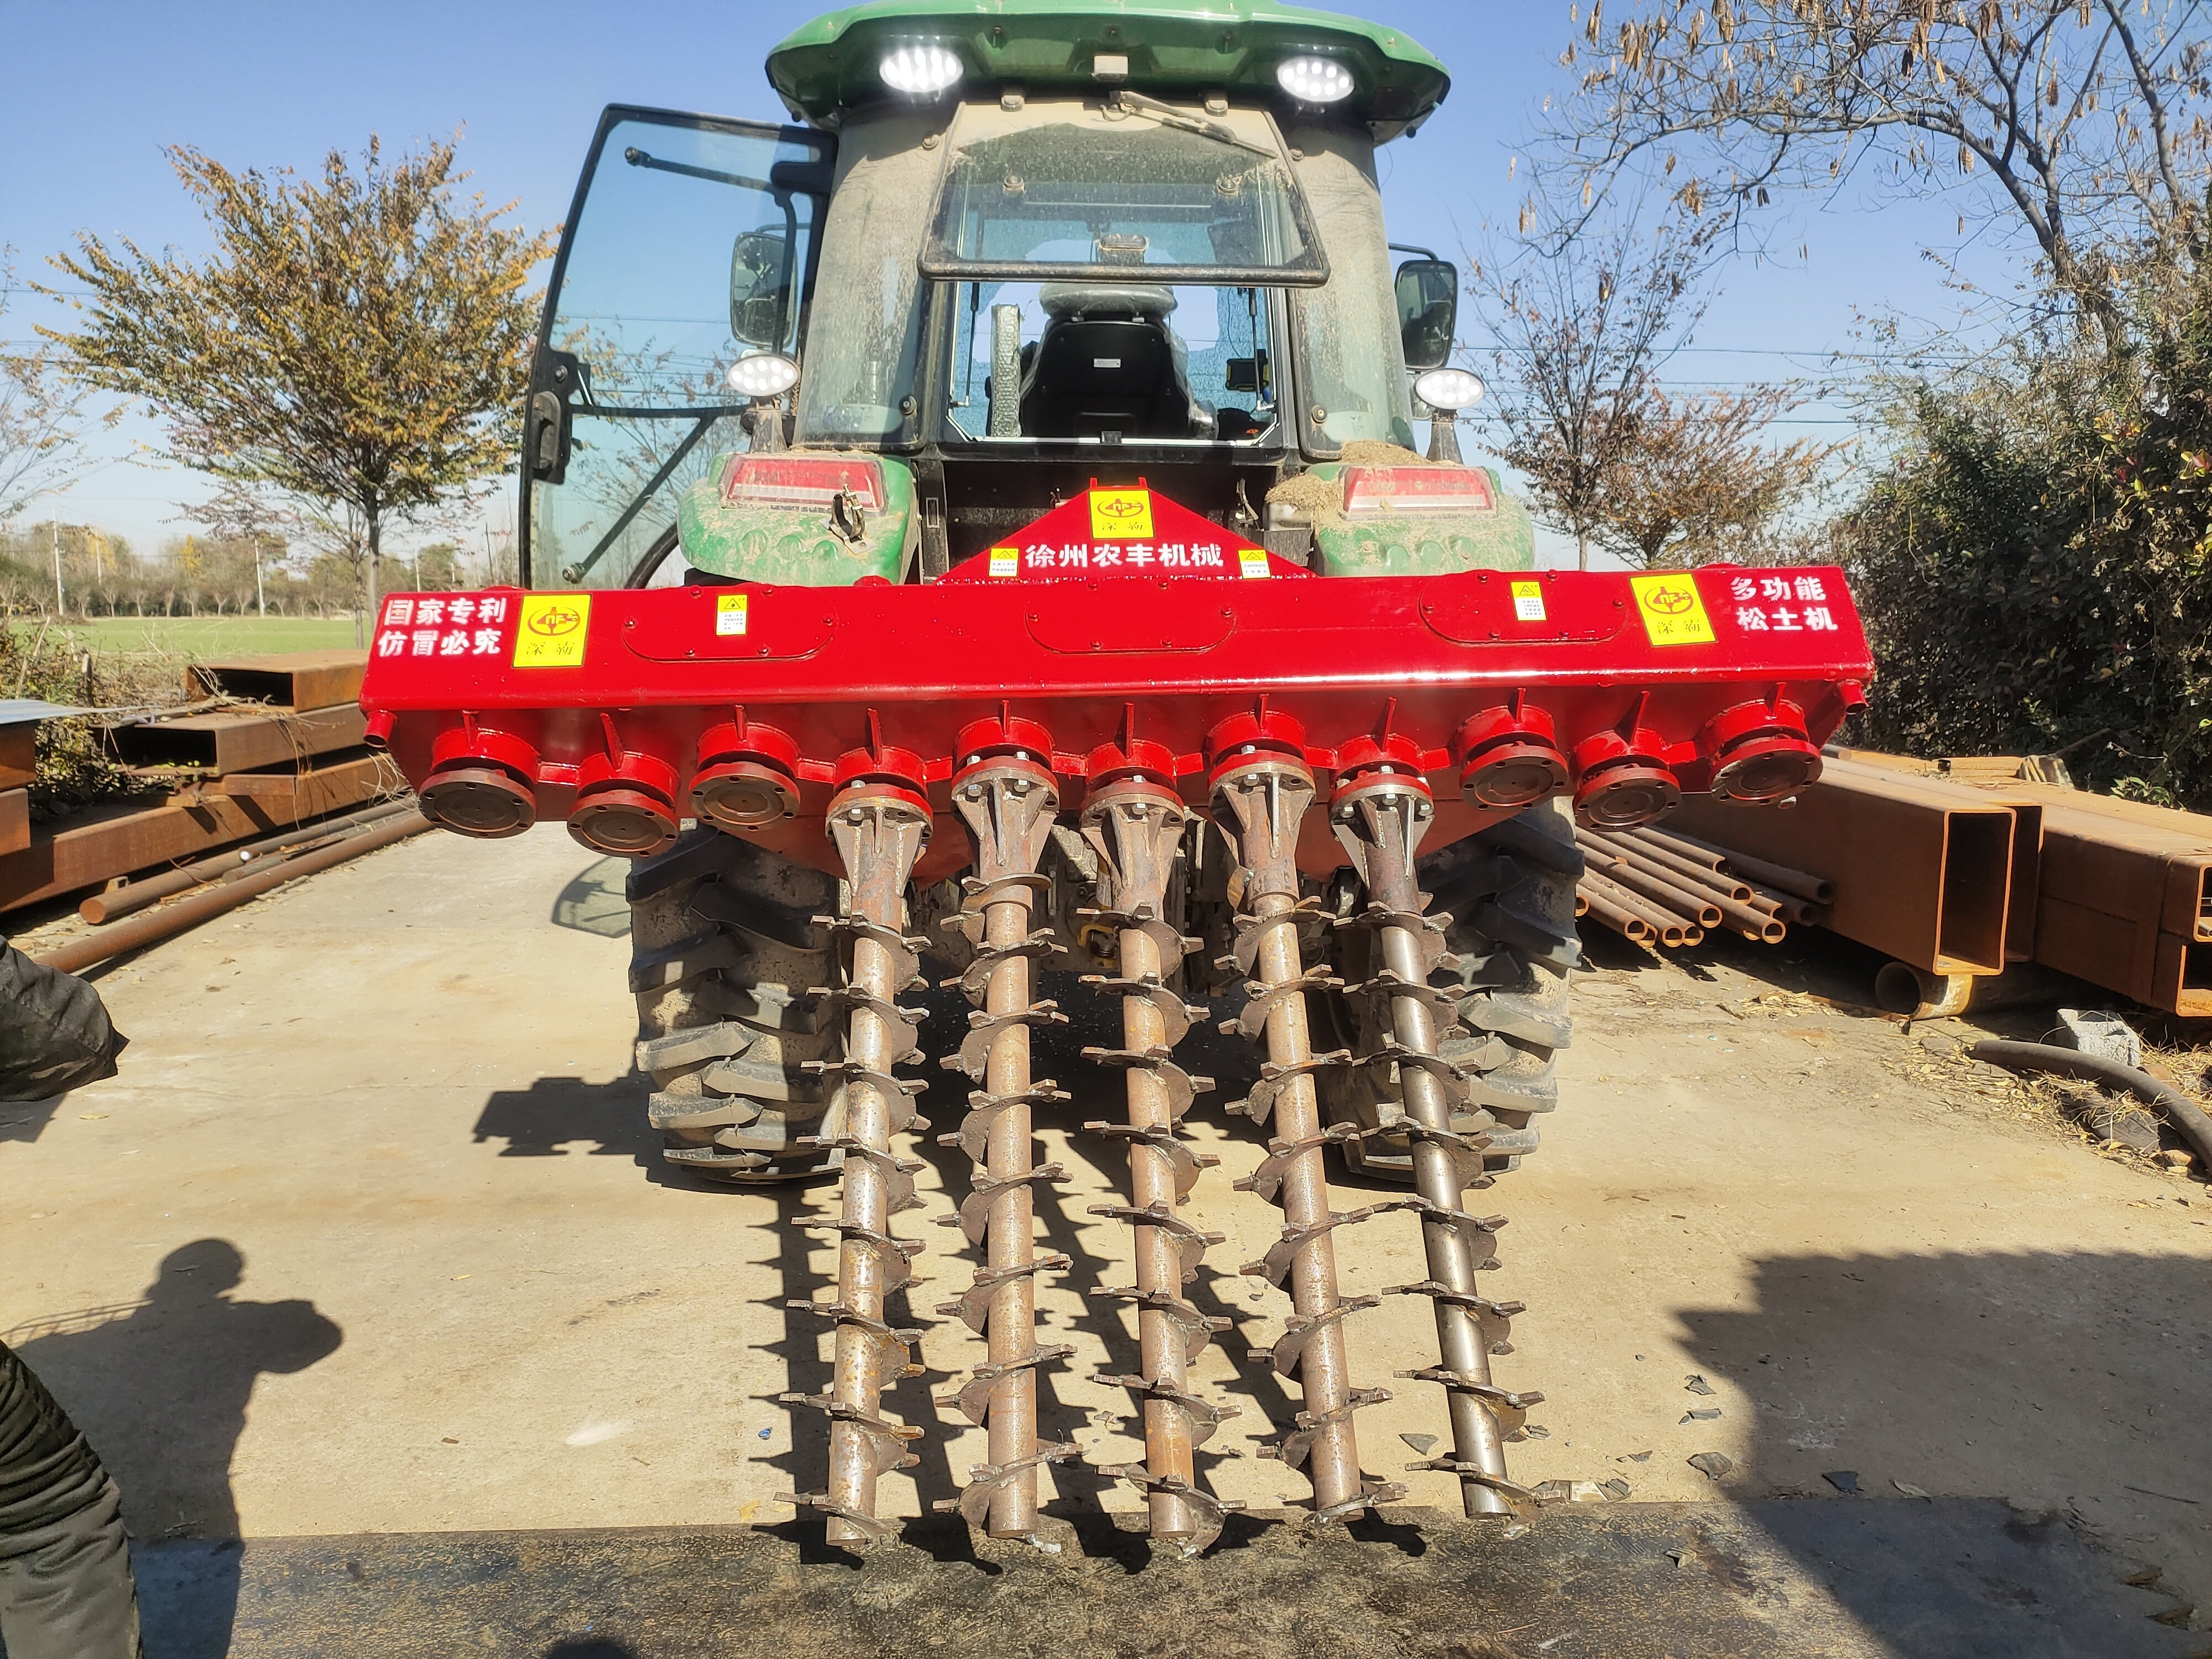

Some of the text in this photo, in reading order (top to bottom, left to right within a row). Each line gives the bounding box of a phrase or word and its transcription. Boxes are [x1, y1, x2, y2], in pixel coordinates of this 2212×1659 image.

[1025, 543, 1224, 568] 徐州农丰机械
[1730, 576, 1826, 601] 多功能
[384, 597, 507, 626] 国家专利
[1736, 607, 1838, 631] 松土机
[378, 628, 502, 658] 仿冒必究
